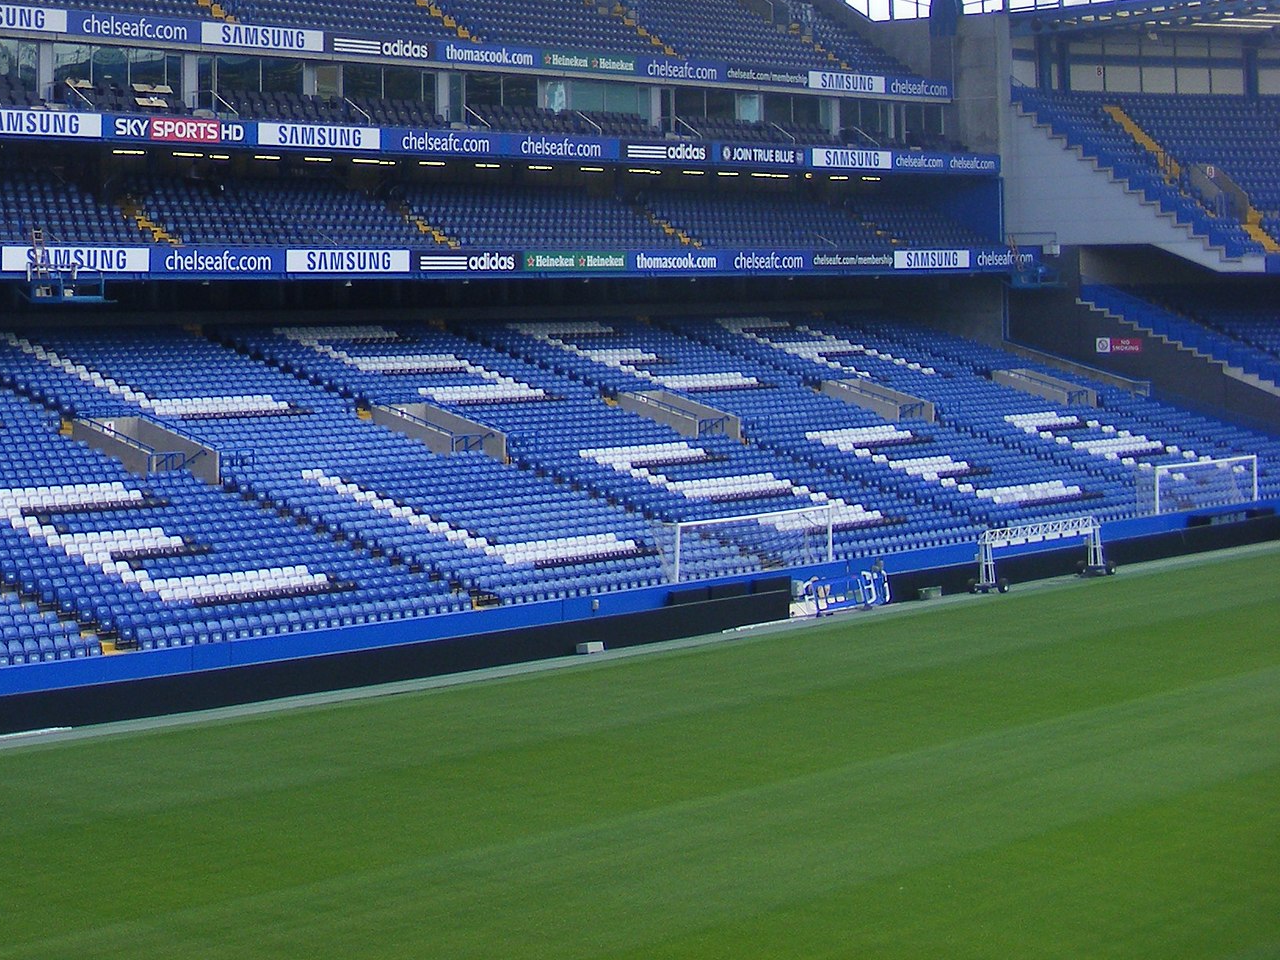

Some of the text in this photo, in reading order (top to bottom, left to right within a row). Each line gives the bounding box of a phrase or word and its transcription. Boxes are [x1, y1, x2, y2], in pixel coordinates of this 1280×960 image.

[83, 16, 187, 41] chelseafc.com
[221, 25, 305, 49] SAMSUNG
[382, 41, 428, 58] adidas
[446, 46, 533, 66] thomascook.com
[648, 60, 717, 80] chelseafc.com
[727, 67, 808, 86] chelseafc.com/membership
[821, 72, 874, 91] SAMSUNG
[891, 80, 947, 96] chelseafc.com
[115, 118, 244, 141] SKY SPORTS HD
[278, 125, 361, 147] SAMSUNG
[402, 134, 489, 152] chelseafc.com
[521, 137, 601, 157] chelseafc.com
[668, 145, 705, 160] adidas
[733, 147, 752, 161] JOIN
[753, 148, 773, 162] TRUE
[773, 149, 794, 163] BLUE
[825, 151, 880, 168] SAMSUNG
[896, 154, 943, 169] chelseafc.com
[950, 156, 994, 170] chelseafc.com
[165, 249, 271, 271] chelseafc.com
[307, 251, 391, 270] SAMSUNG
[469, 254, 514, 270] adidas
[636, 254, 716, 269] thomascook.com
[734, 252, 803, 269] chelseafc.com
[813, 255, 893, 267] chelseafc.com/membership
[906, 252, 958, 267] SAMSUNG
